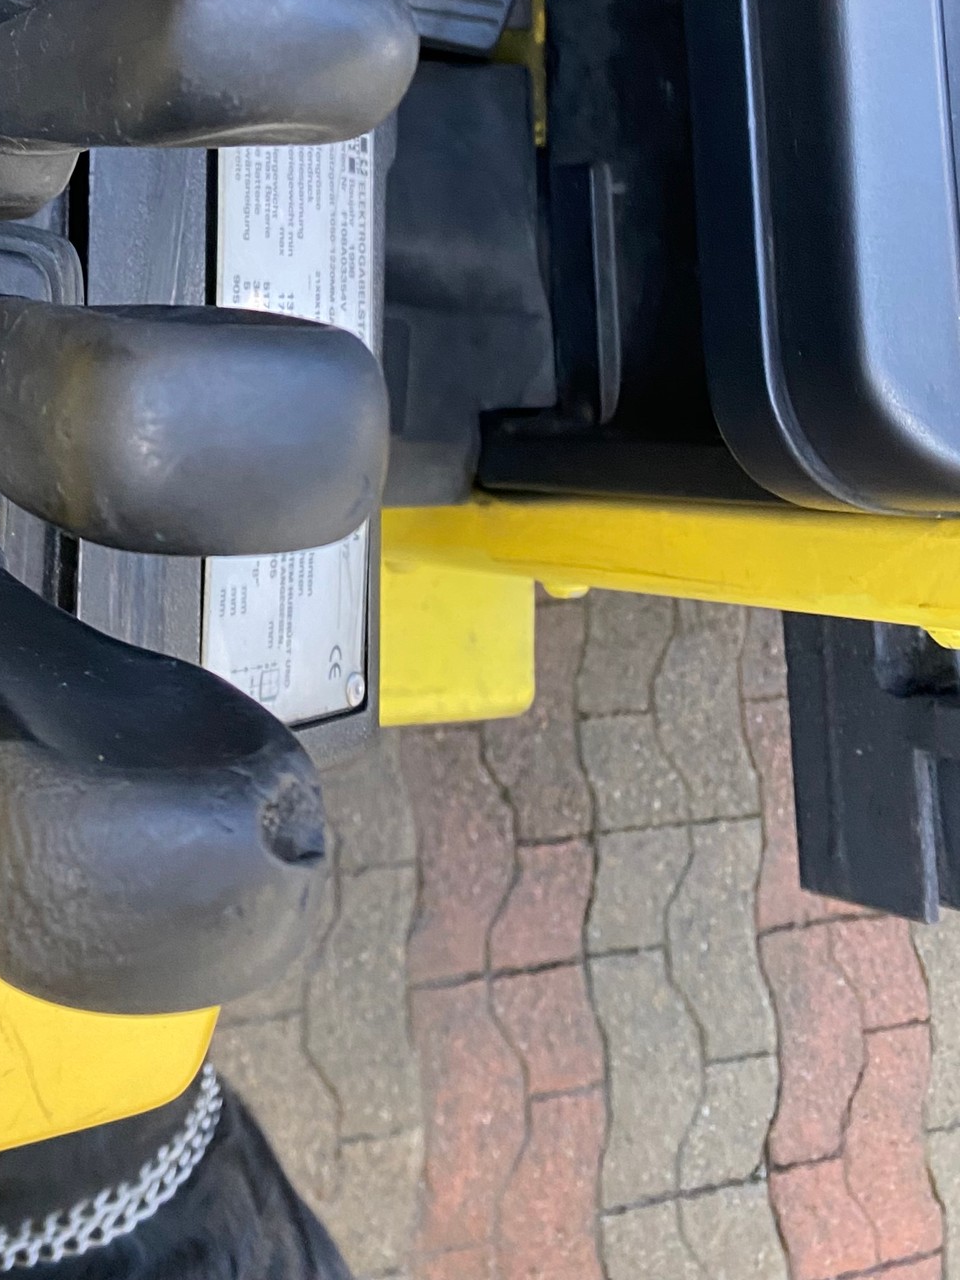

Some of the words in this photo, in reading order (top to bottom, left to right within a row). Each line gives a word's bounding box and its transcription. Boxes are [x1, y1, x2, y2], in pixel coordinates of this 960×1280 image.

[254, 161, 262, 216] Batterie
[264, 150, 272, 181] max
[287, 146, 295, 228] eriegewicht
[306, 146, 314, 203] fendruck
[315, 146, 323, 211] fengrösse
[328, 144, 336, 206] satzgerät
[341, 176, 348, 192] Nr
[243, 147, 252, 241] wärtsneigung
[264, 184, 273, 239] Batterie
[348, 178, 356, 227] Baujahr
[348, 244, 356, 279] 1998
[232, 274, 241, 304] 905
[219, 588, 226, 619] mm
[230, 586, 237, 617] mm
[240, 585, 247, 615] mm
